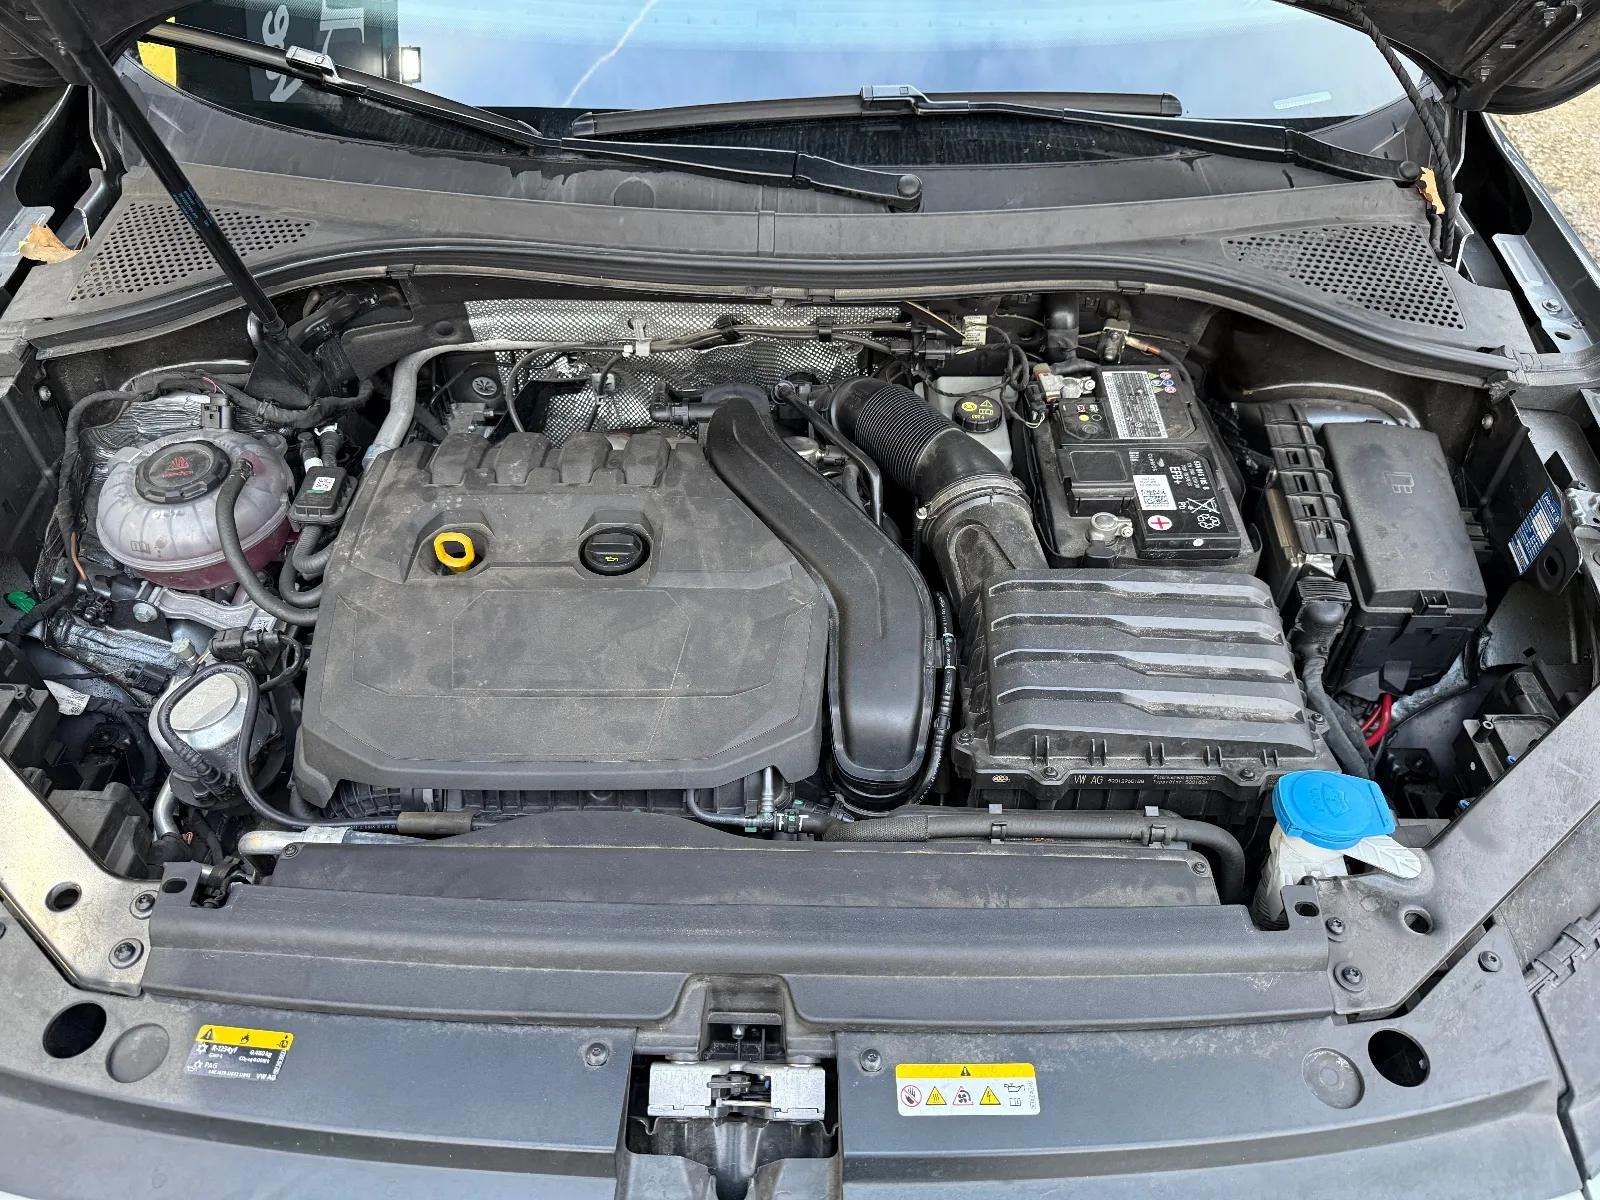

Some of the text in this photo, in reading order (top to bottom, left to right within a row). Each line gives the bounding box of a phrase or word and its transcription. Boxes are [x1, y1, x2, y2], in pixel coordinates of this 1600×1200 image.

[1170, 467, 1183, 484] EFB+
[1178, 502, 1187, 510] Pb
[1074, 775, 1087, 784] VW
[1091, 776, 1104, 784] AG
[211, 1044, 238, 1054] R-1234yf
